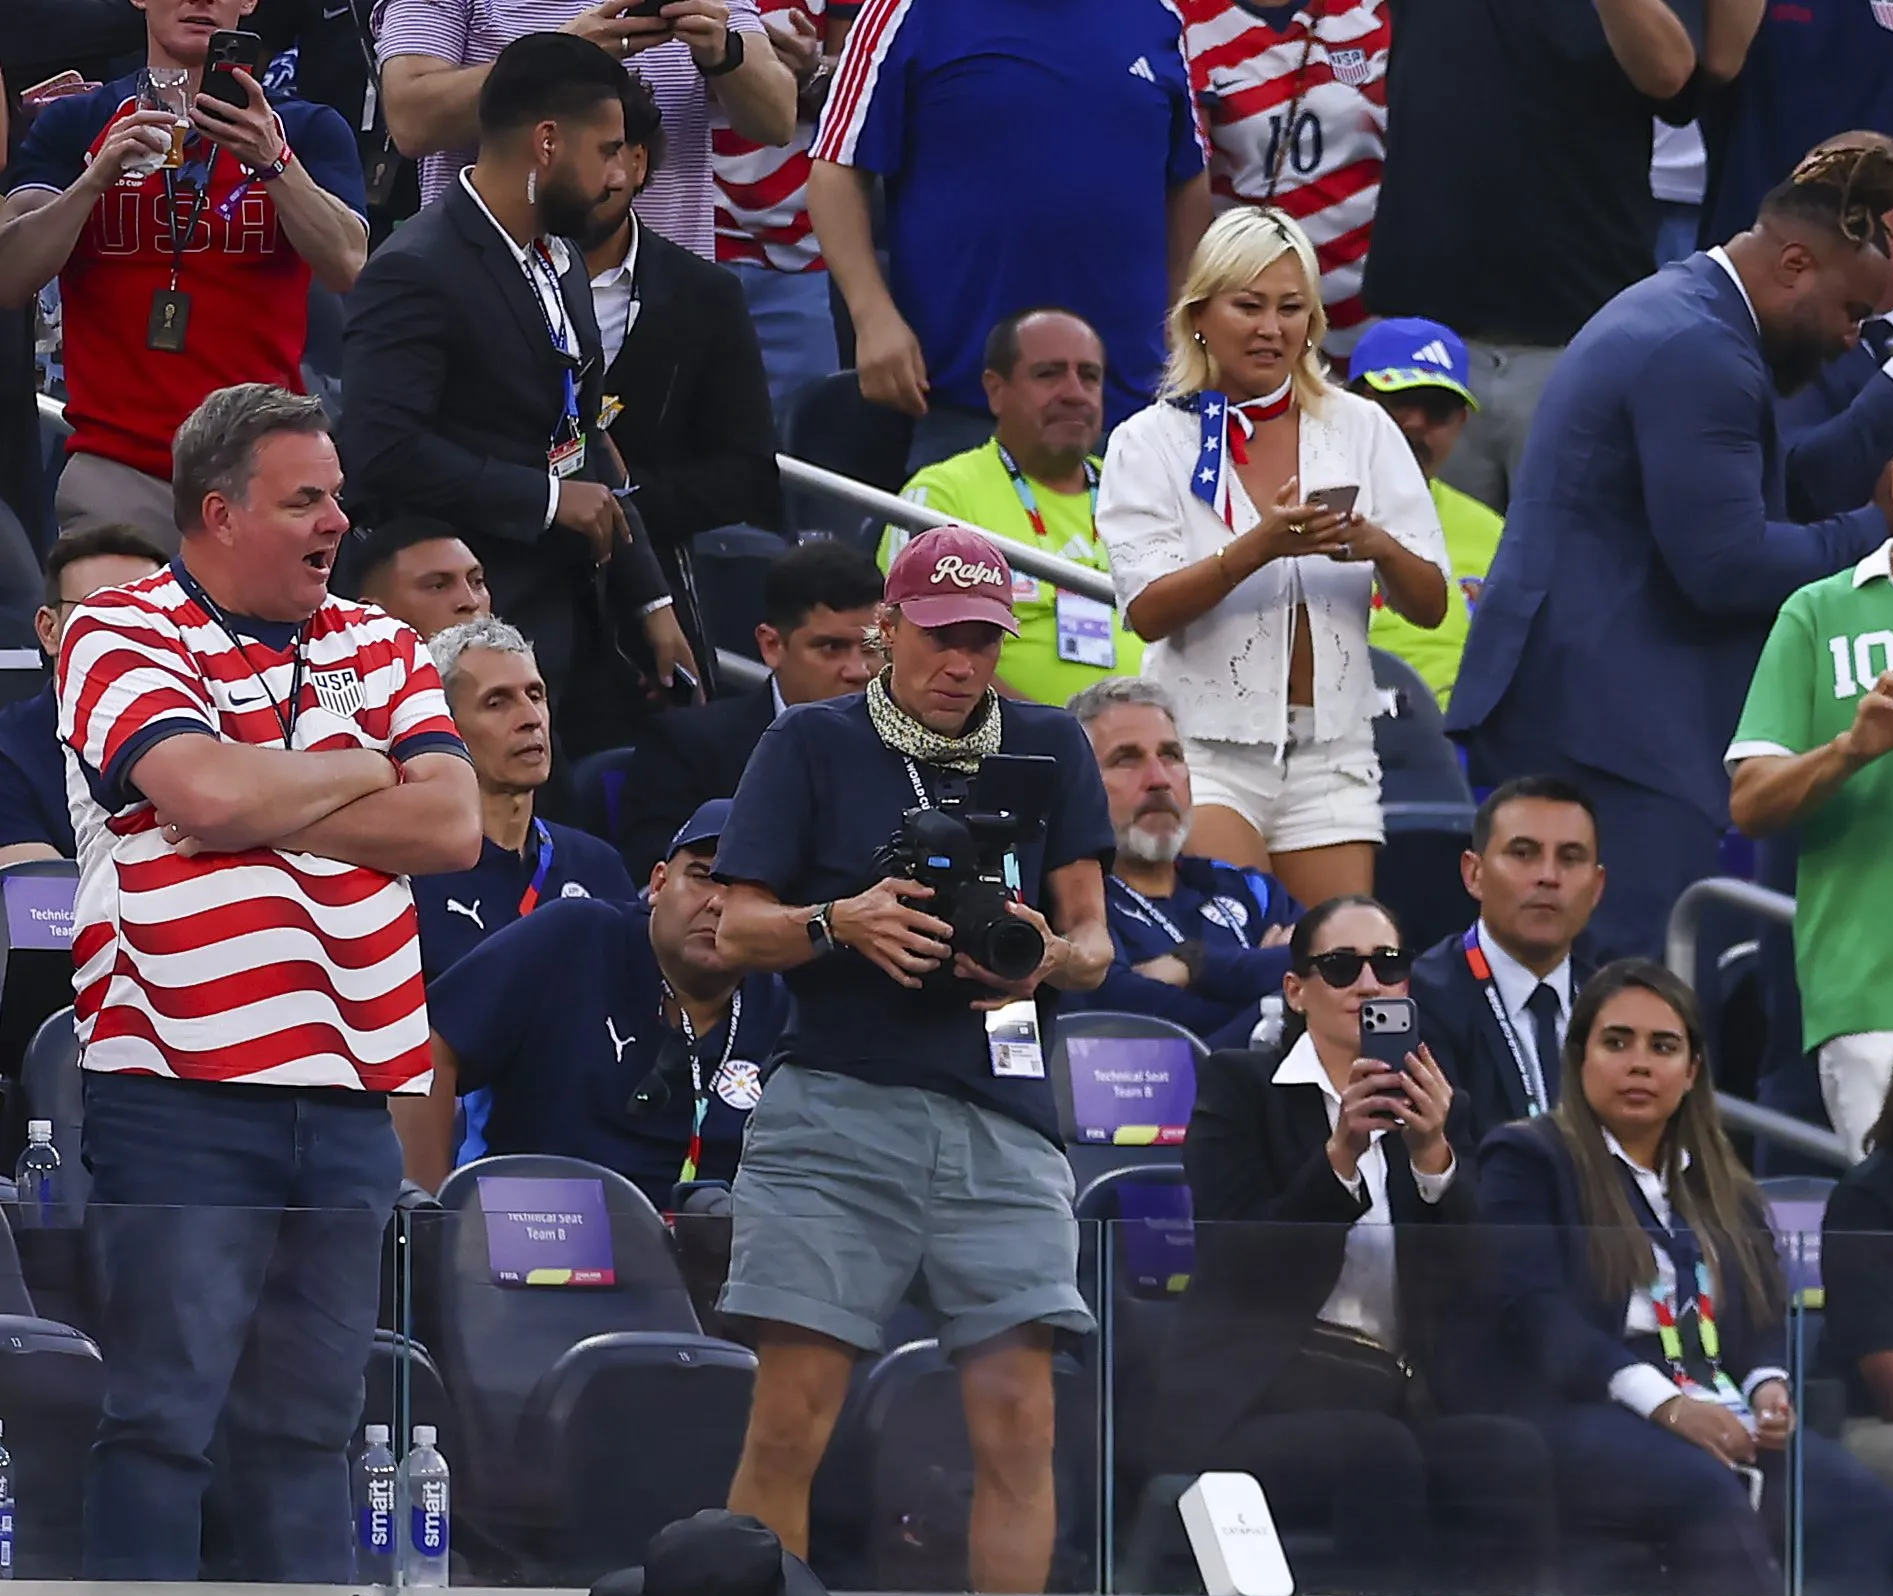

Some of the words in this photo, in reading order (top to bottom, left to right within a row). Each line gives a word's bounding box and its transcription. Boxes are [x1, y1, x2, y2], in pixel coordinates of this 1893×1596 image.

[1263, 110, 1323, 181] 10
[97, 192, 279, 255] USA
[930, 555, 1004, 588] Ralph
[315, 671, 355, 691] USA
[906, 763, 926, 799] WORLD
[919, 796, 932, 811] CU
[29, 908, 76, 922] Technica
[708, 1069, 721, 1092] FIFA
[526, 1227, 556, 1241] Team
[499, 1271, 519, 1282] FIFA
[371, 1479, 389, 1546] smart
[423, 1481, 440, 1548] smart
